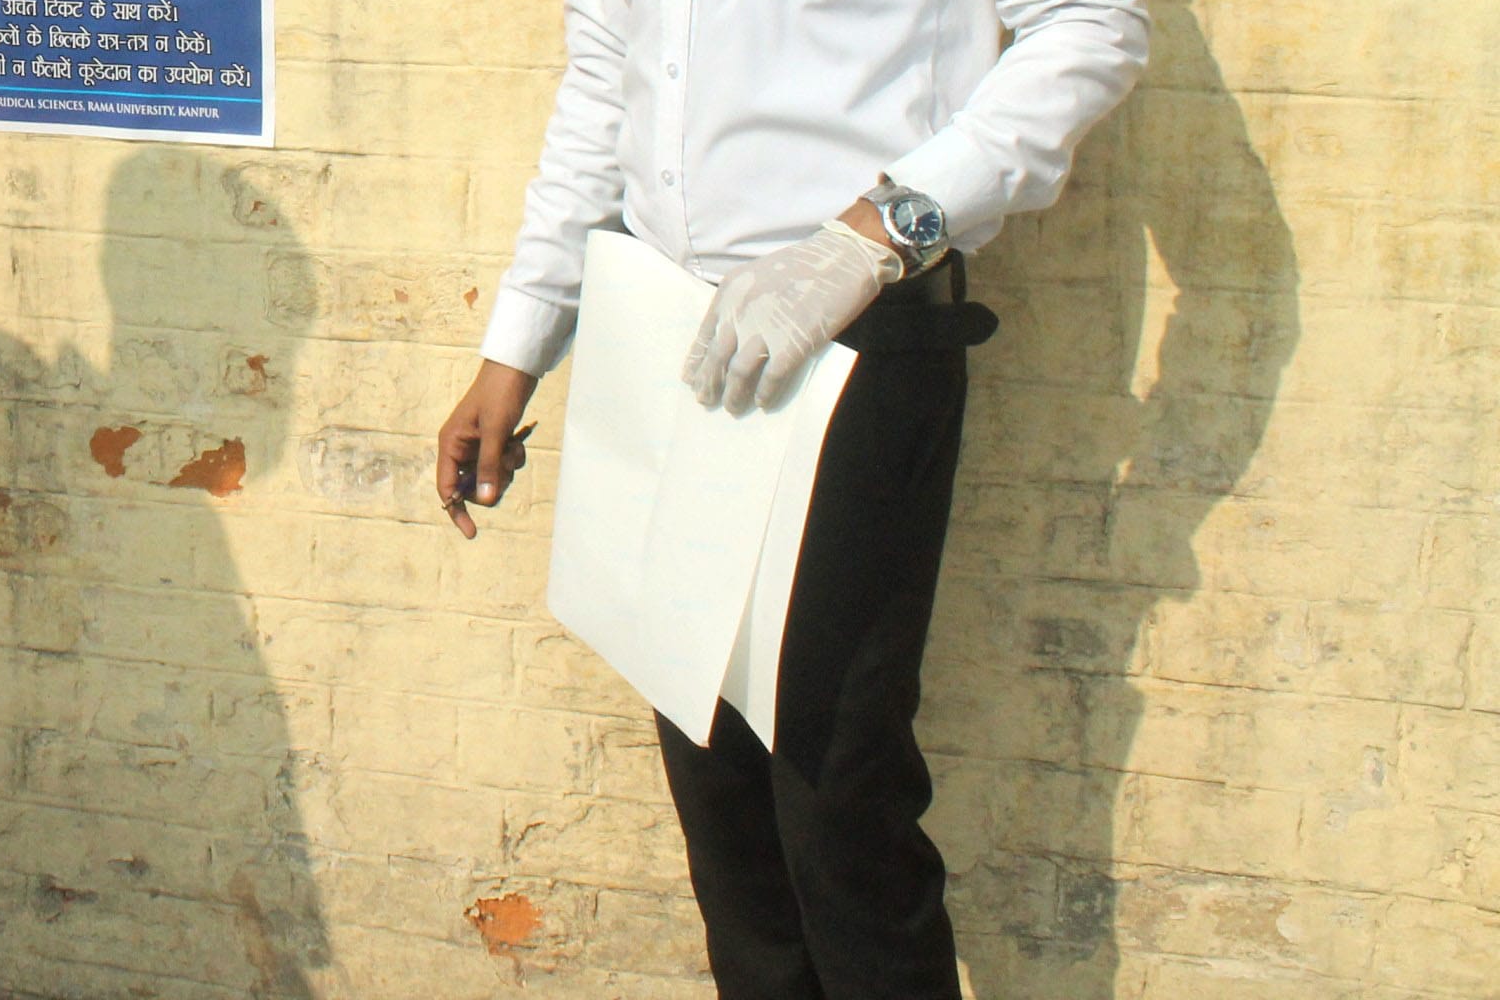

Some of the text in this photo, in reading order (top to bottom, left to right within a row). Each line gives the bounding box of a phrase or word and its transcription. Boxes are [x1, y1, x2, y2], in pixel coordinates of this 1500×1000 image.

[113, 3, 141, 20] साथ
[27, 25, 41, 46] के
[49, 24, 91, 48] छिलके
[98, 34, 148, 51] यत्र-तत्र
[156, 36, 168, 52] न
[13, 61, 25, 76] न
[32, 55, 71, 78] फैलायें
[138, 66, 157, 82] का
[165, 62, 212, 84] उपयोग
[88, 101, 115, 112] RAMA
[179, 106, 219, 118] KANPUR
